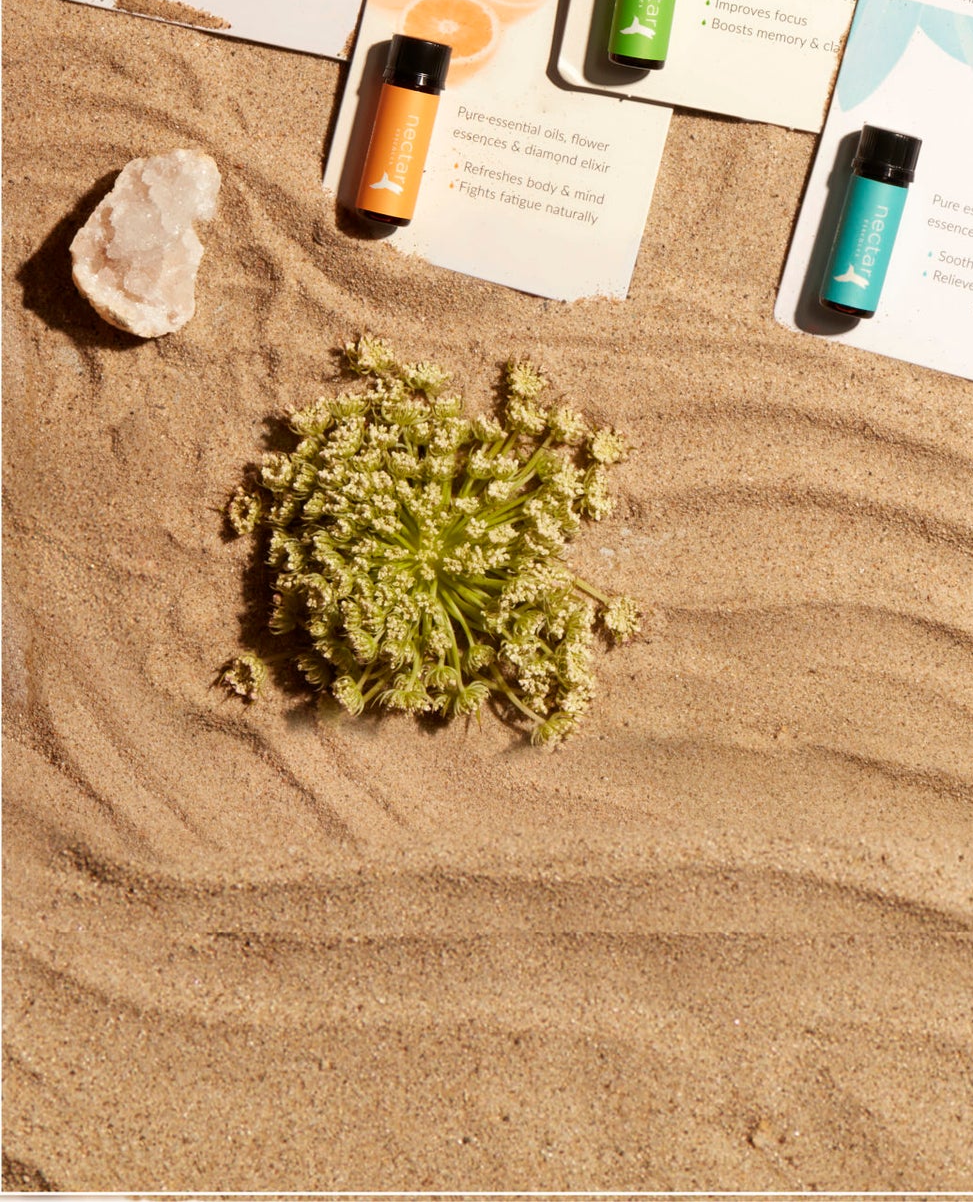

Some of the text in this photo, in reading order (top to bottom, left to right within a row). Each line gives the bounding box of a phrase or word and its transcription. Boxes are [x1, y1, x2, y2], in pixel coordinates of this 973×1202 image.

[712, 18, 753, 37] Boosts
[756, 29, 807, 48] memory
[810, 38, 819, 50] &
[774, 10, 808, 27] focus
[393, 115, 420, 185] nectar
[452, 128, 611, 174] essences & diamond elixir
[458, 106, 610, 152] Pure essential oils, flower
[459, 181, 598, 226] Fights fatigue naturally
[464, 161, 605, 205] Refreshes body & mind
[933, 194, 960, 211] Pure
[860, 205, 889, 278] nectar
